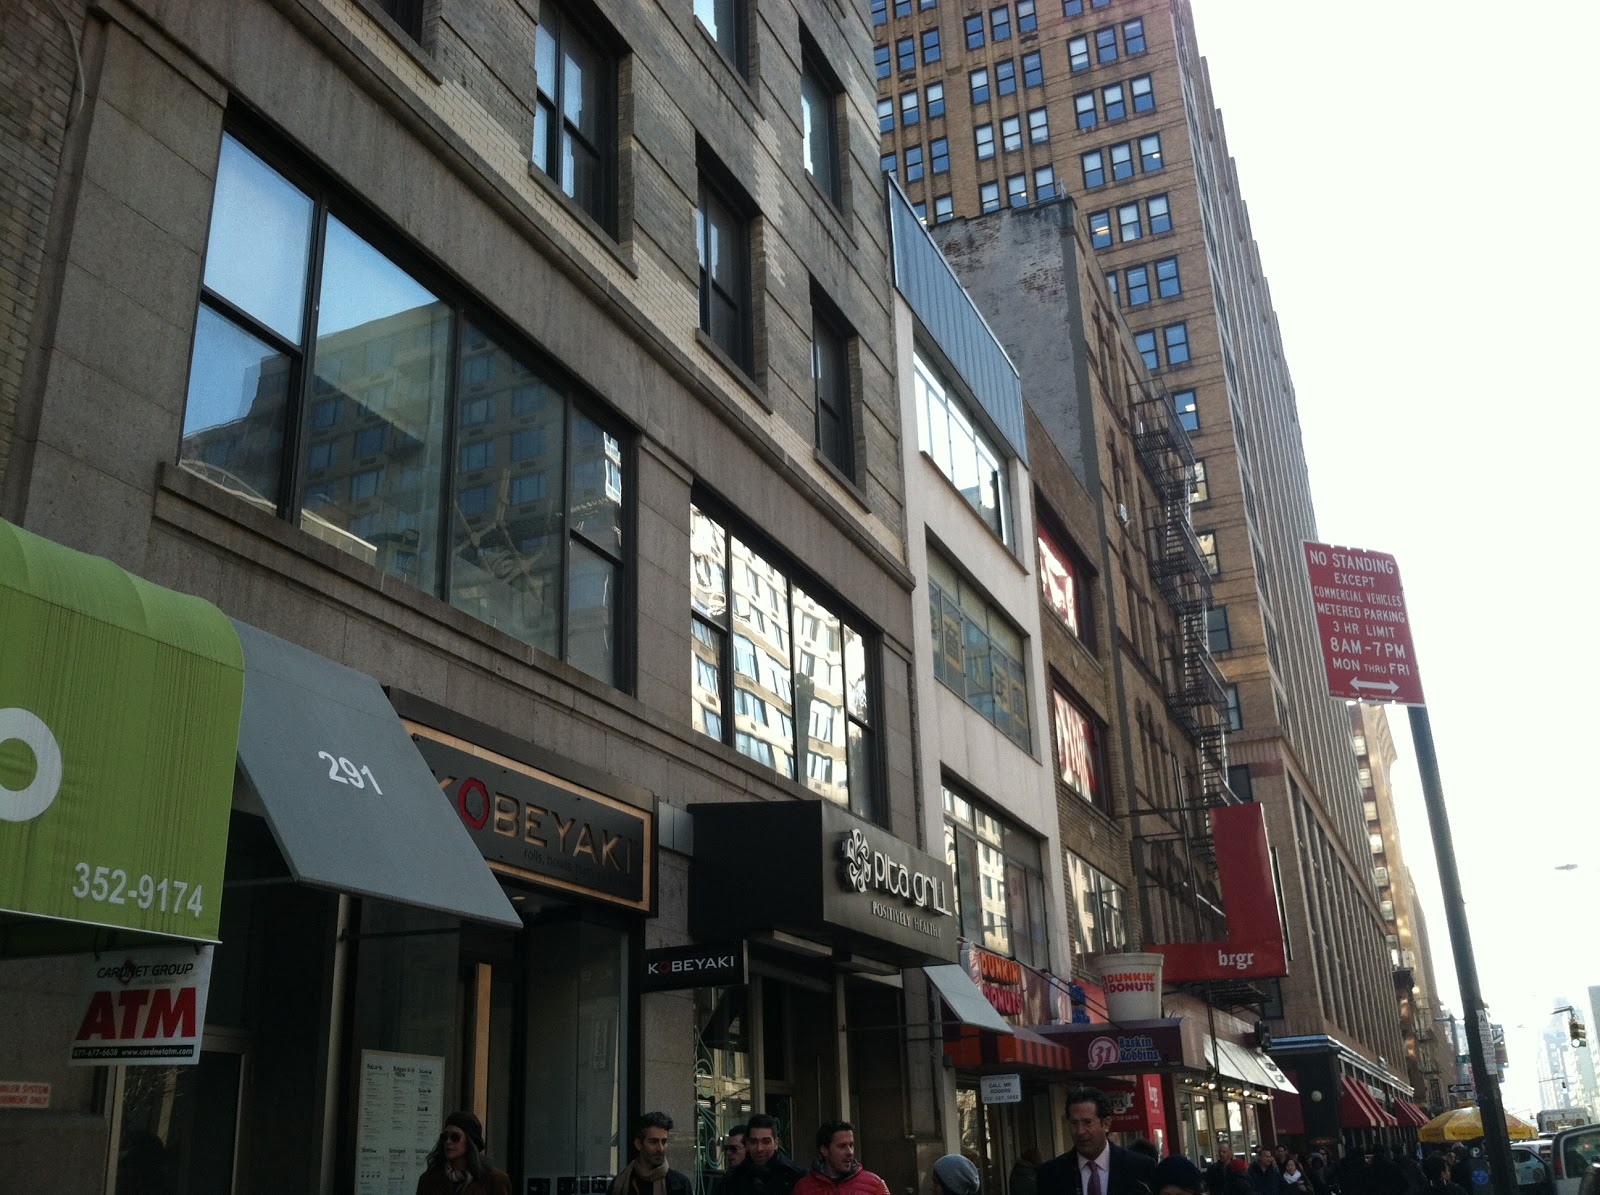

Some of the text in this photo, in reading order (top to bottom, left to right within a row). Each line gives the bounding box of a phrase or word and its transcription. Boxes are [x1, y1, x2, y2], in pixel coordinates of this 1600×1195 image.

[1309, 550, 1394, 574] NO STANDING
[1333, 572, 1375, 588] EXCEPT
[1313, 585, 1402, 607] COMMERCIAL VEHICLES
[1316, 602, 1406, 623] METERED PARKING
[1333, 620, 1395, 638] 3 HR LIMIT
[1332, 657, 1410, 676] MON THRU FRI
[317, 750, 384, 796] 291
[440, 776, 632, 875] OBEYAKI
[72, 862, 204, 917] 352-9174
[872, 901, 941, 939] POSITIVELY HEALTHY
[647, 955, 735, 975] KOBEYAKI
[1218, 949, 1254, 970] brgr
[96, 962, 194, 979] CARDNET GROUP
[1109, 982, 1155, 993] DONUTS
[75, 987, 197, 1041] ATM
[1118, 1035, 1153, 1049] Baskin
[1118, 1048, 1160, 1062] Robbins
